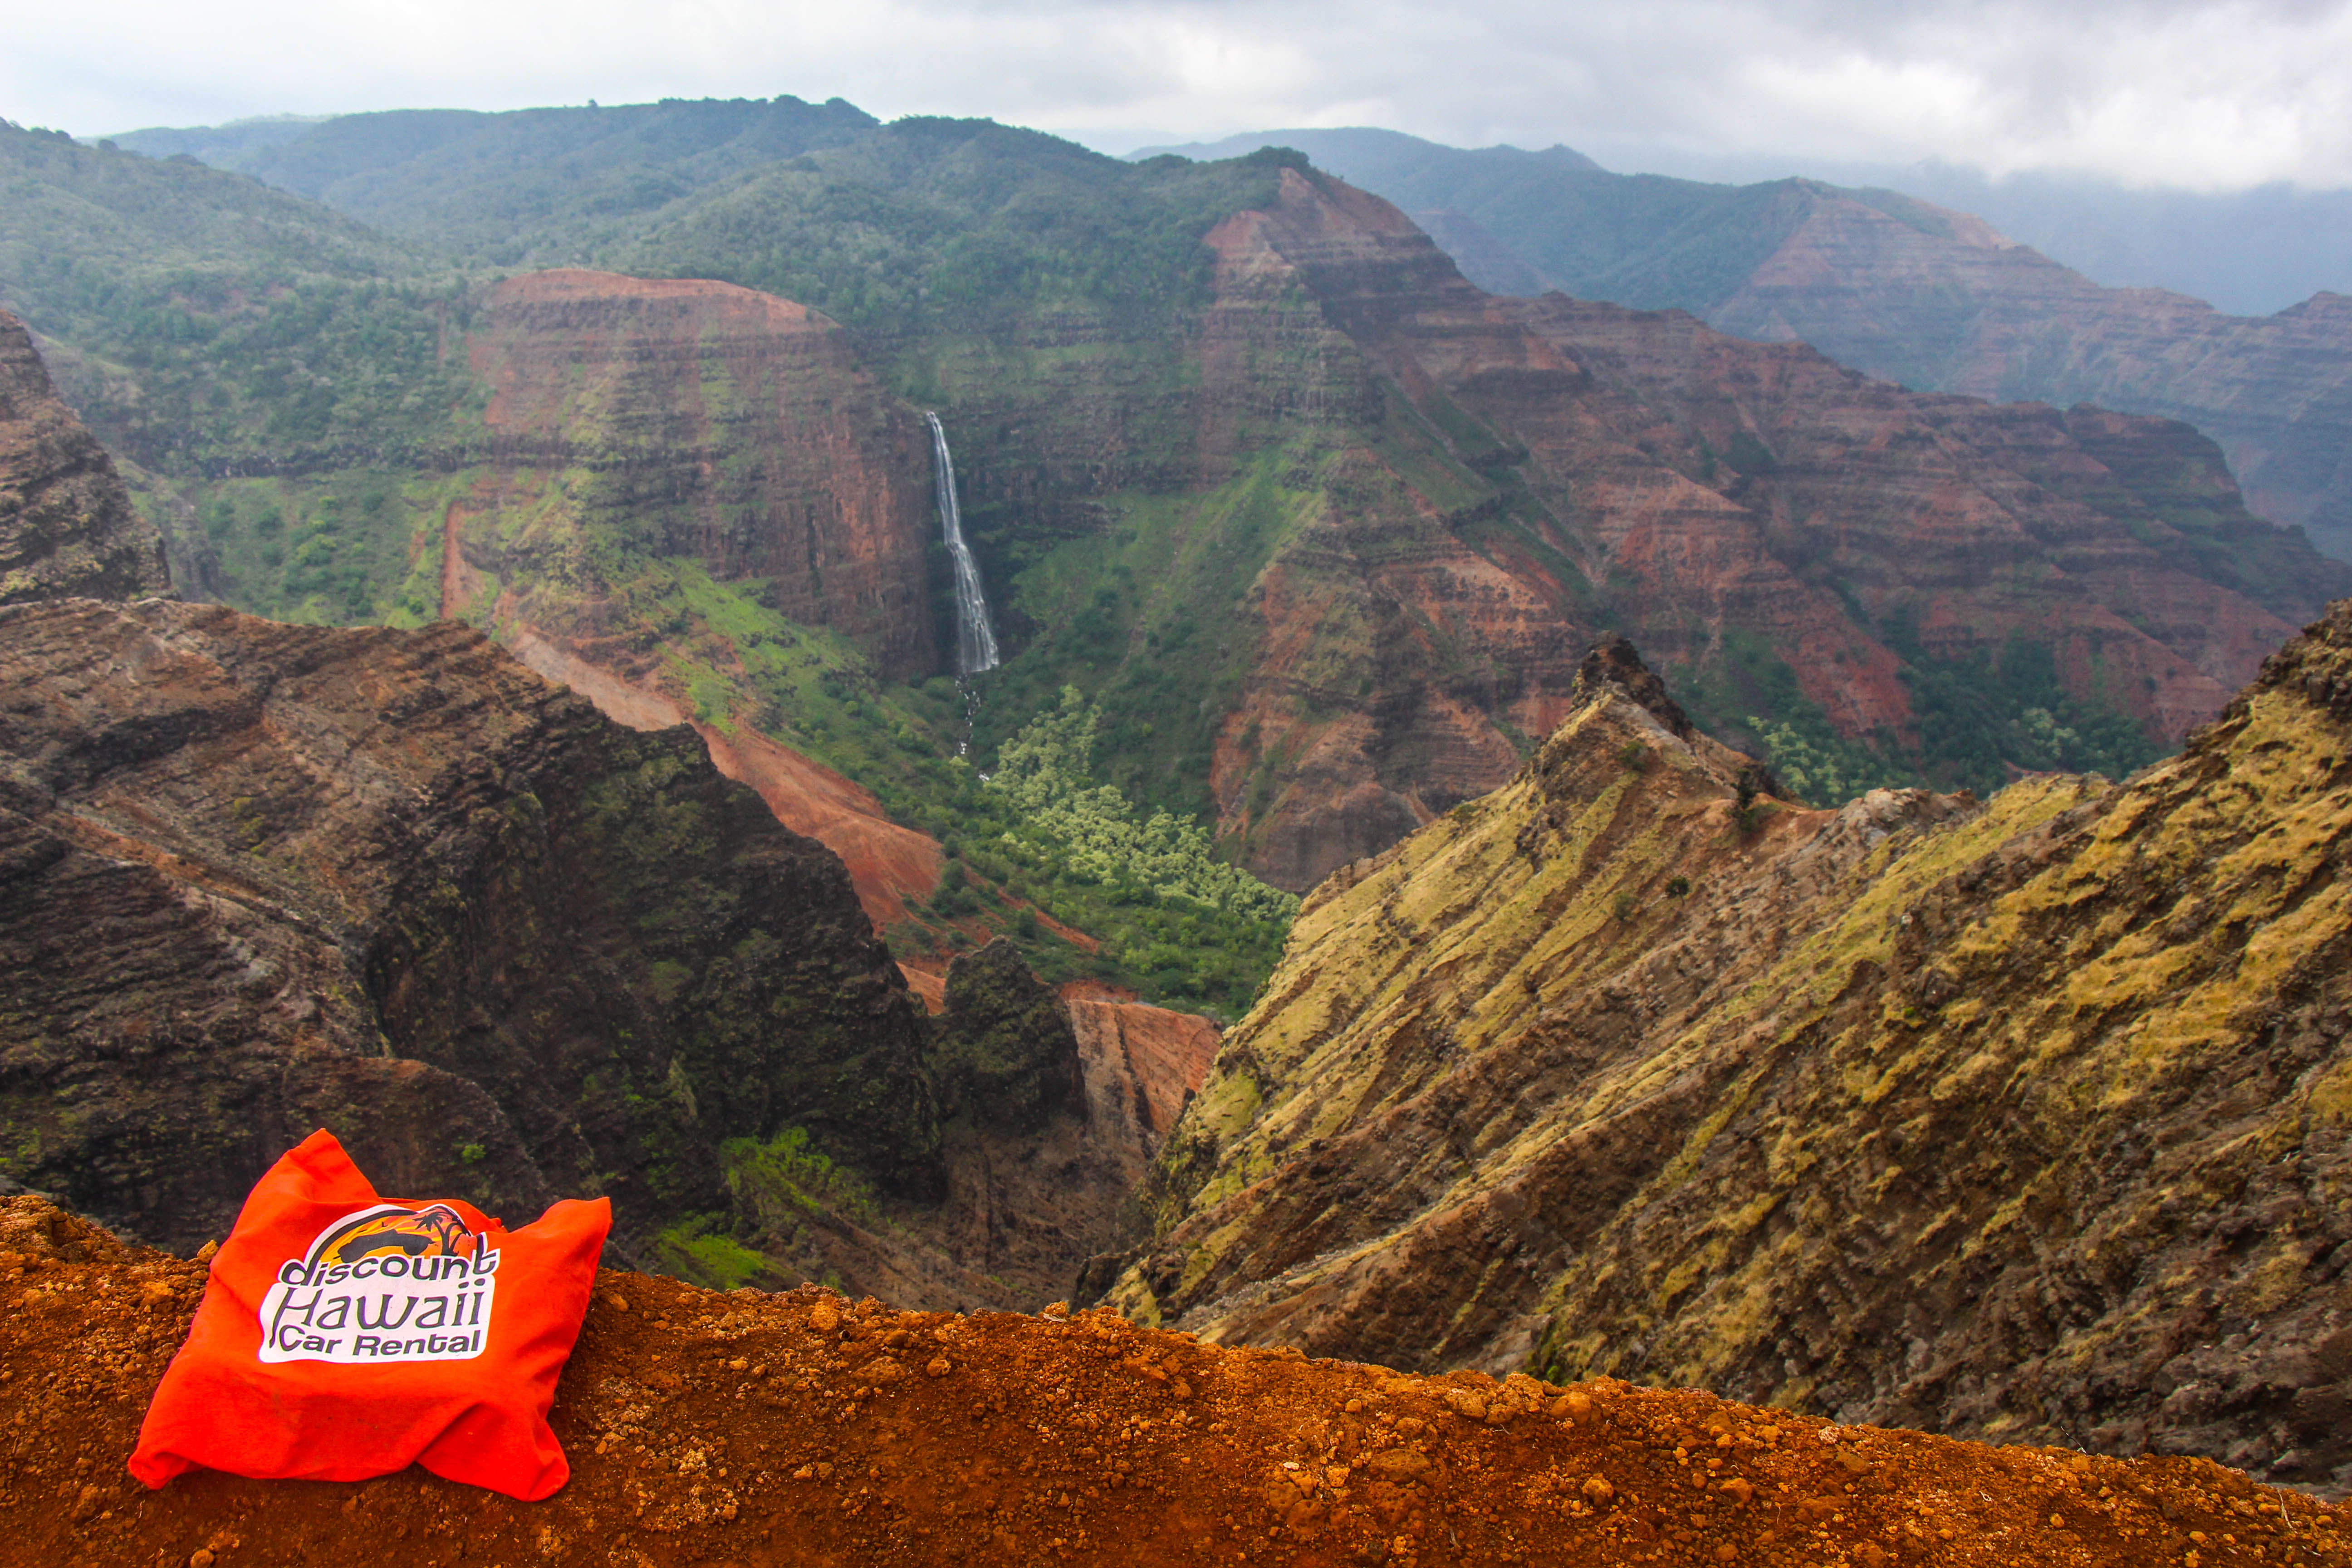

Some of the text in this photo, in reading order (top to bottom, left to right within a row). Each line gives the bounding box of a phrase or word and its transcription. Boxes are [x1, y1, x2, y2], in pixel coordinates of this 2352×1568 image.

[281, 1234, 496, 1287] discount
[269, 1278, 485, 1348] Hawaii
[279, 1325, 480, 1356] Car Rental
